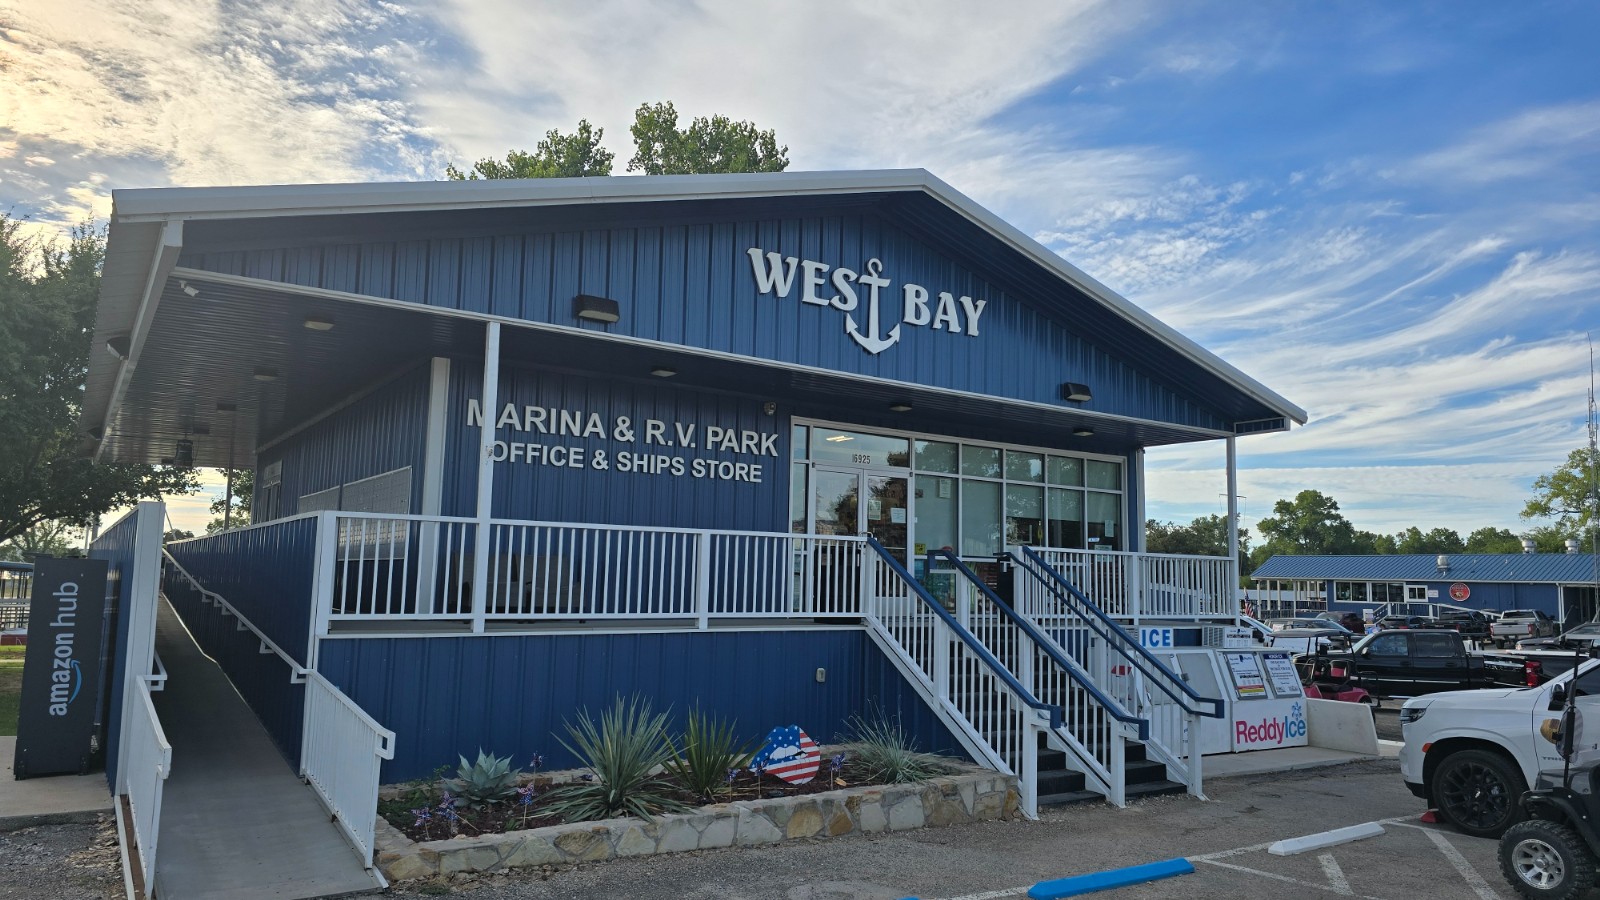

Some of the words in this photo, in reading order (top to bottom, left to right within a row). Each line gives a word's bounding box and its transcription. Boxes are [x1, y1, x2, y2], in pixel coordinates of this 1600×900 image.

[746, 247, 900, 355] WEST
[902, 283, 987, 337] BAY
[613, 415, 636, 443] &
[645, 419, 696, 448] R.V.
[706, 425, 779, 457] PARK
[492, 440, 585, 468] OFFICE
[591, 449, 609, 470] &
[616, 451, 685, 476] SHIPS
[691, 458, 763, 483] STORE
[50, 581, 79, 627] hub
[1141, 628, 1171, 647] ICE
[49, 632, 75, 716] amazon
